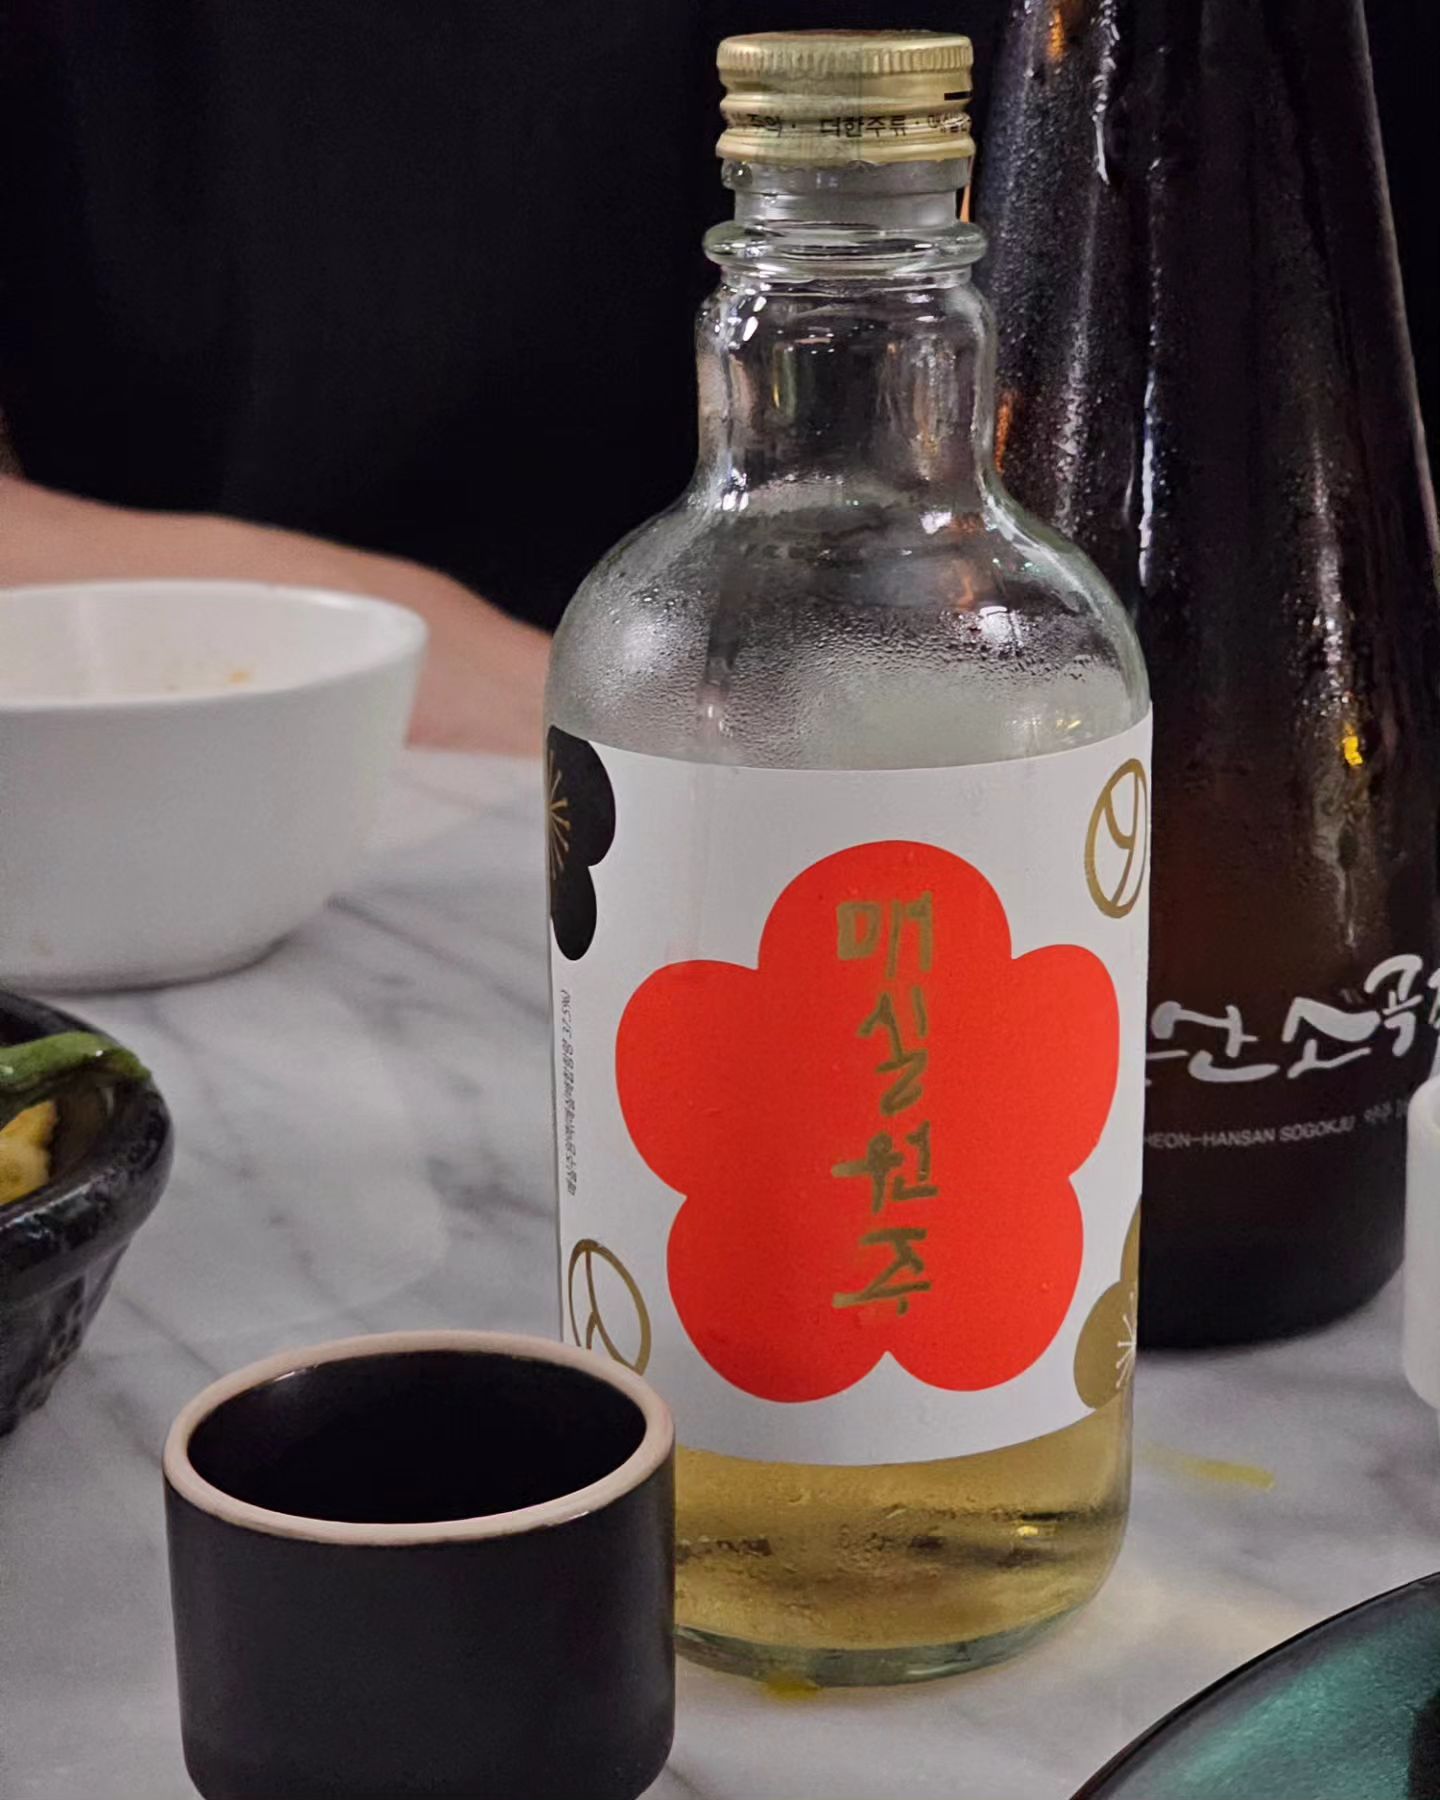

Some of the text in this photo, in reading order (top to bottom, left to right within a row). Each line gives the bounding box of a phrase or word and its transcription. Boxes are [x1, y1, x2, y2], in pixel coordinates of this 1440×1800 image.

[817, 114, 906, 138] 더한주류
[1146, 953, 1440, 1086] 산소곡
[830, 890, 940, 1317] 매실원주
